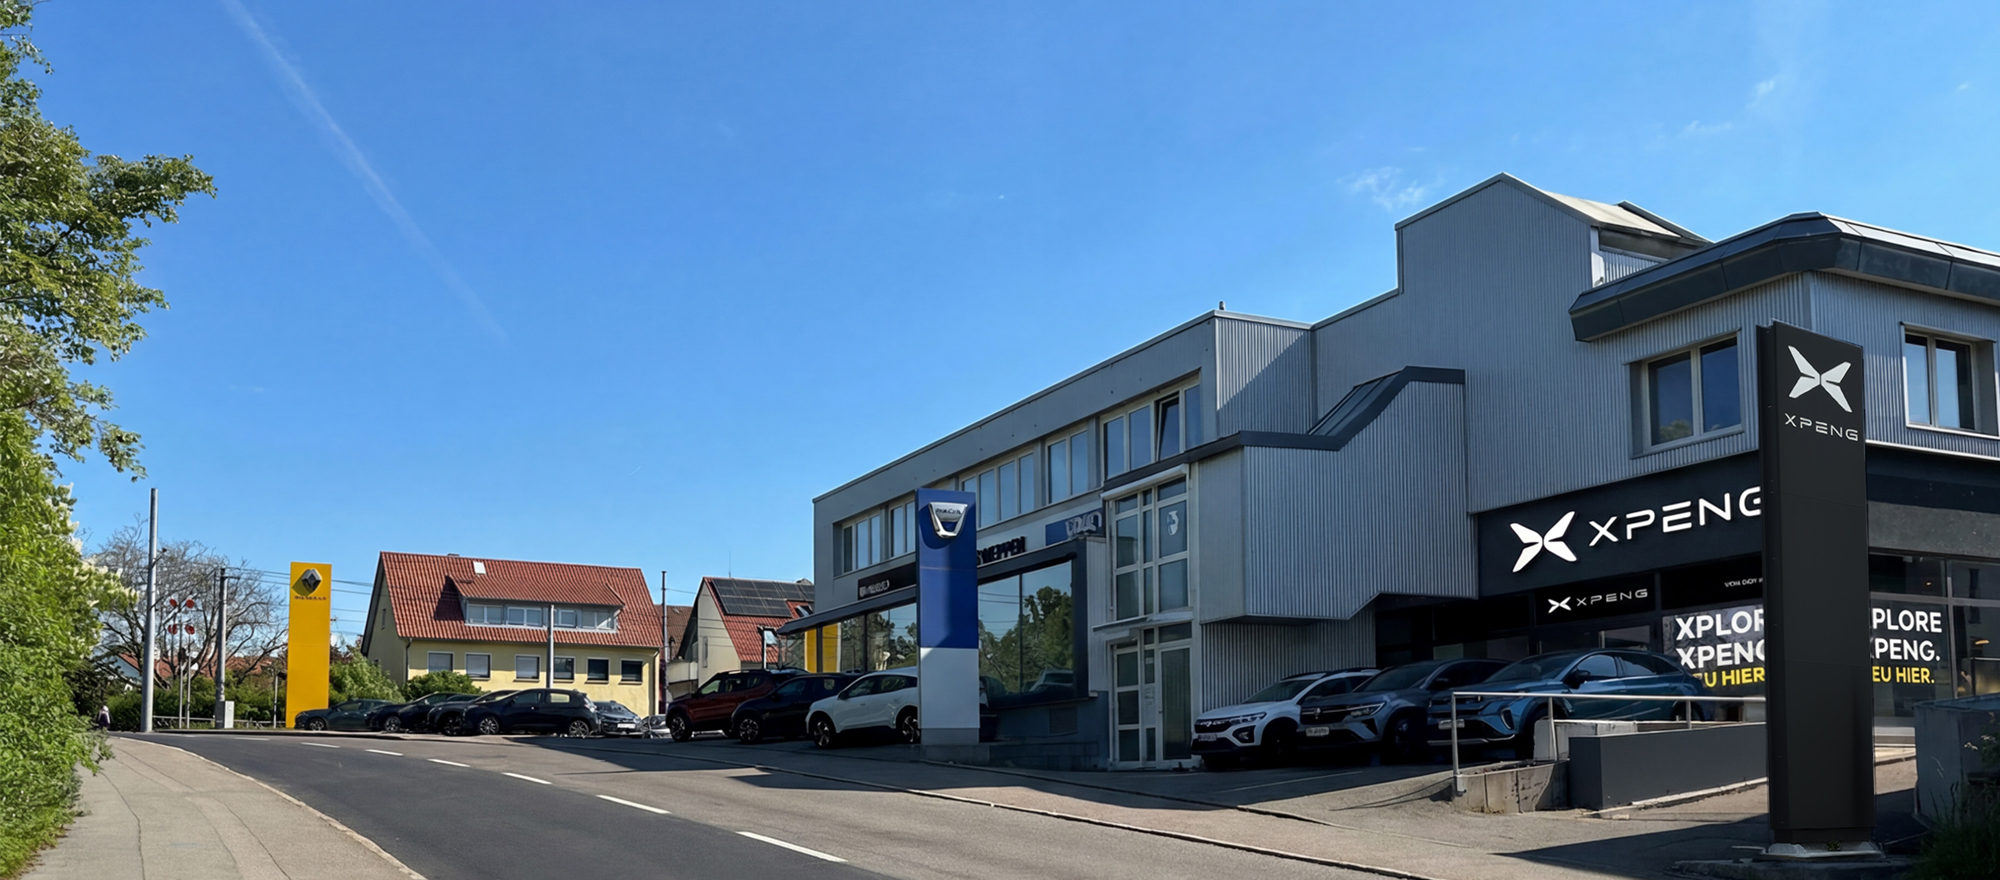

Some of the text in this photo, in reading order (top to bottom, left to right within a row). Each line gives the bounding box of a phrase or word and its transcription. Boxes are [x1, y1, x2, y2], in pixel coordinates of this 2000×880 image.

[1785, 413, 1858, 441] XPENG
[1588, 486, 1762, 547] XPENG
[1576, 588, 1648, 607] XPENG
[1675, 608, 1764, 640] XPLOR
[1872, 607, 1942, 633] PLORE
[1870, 637, 1941, 662] PENG.
[1872, 665, 1935, 684] EU HIER.
